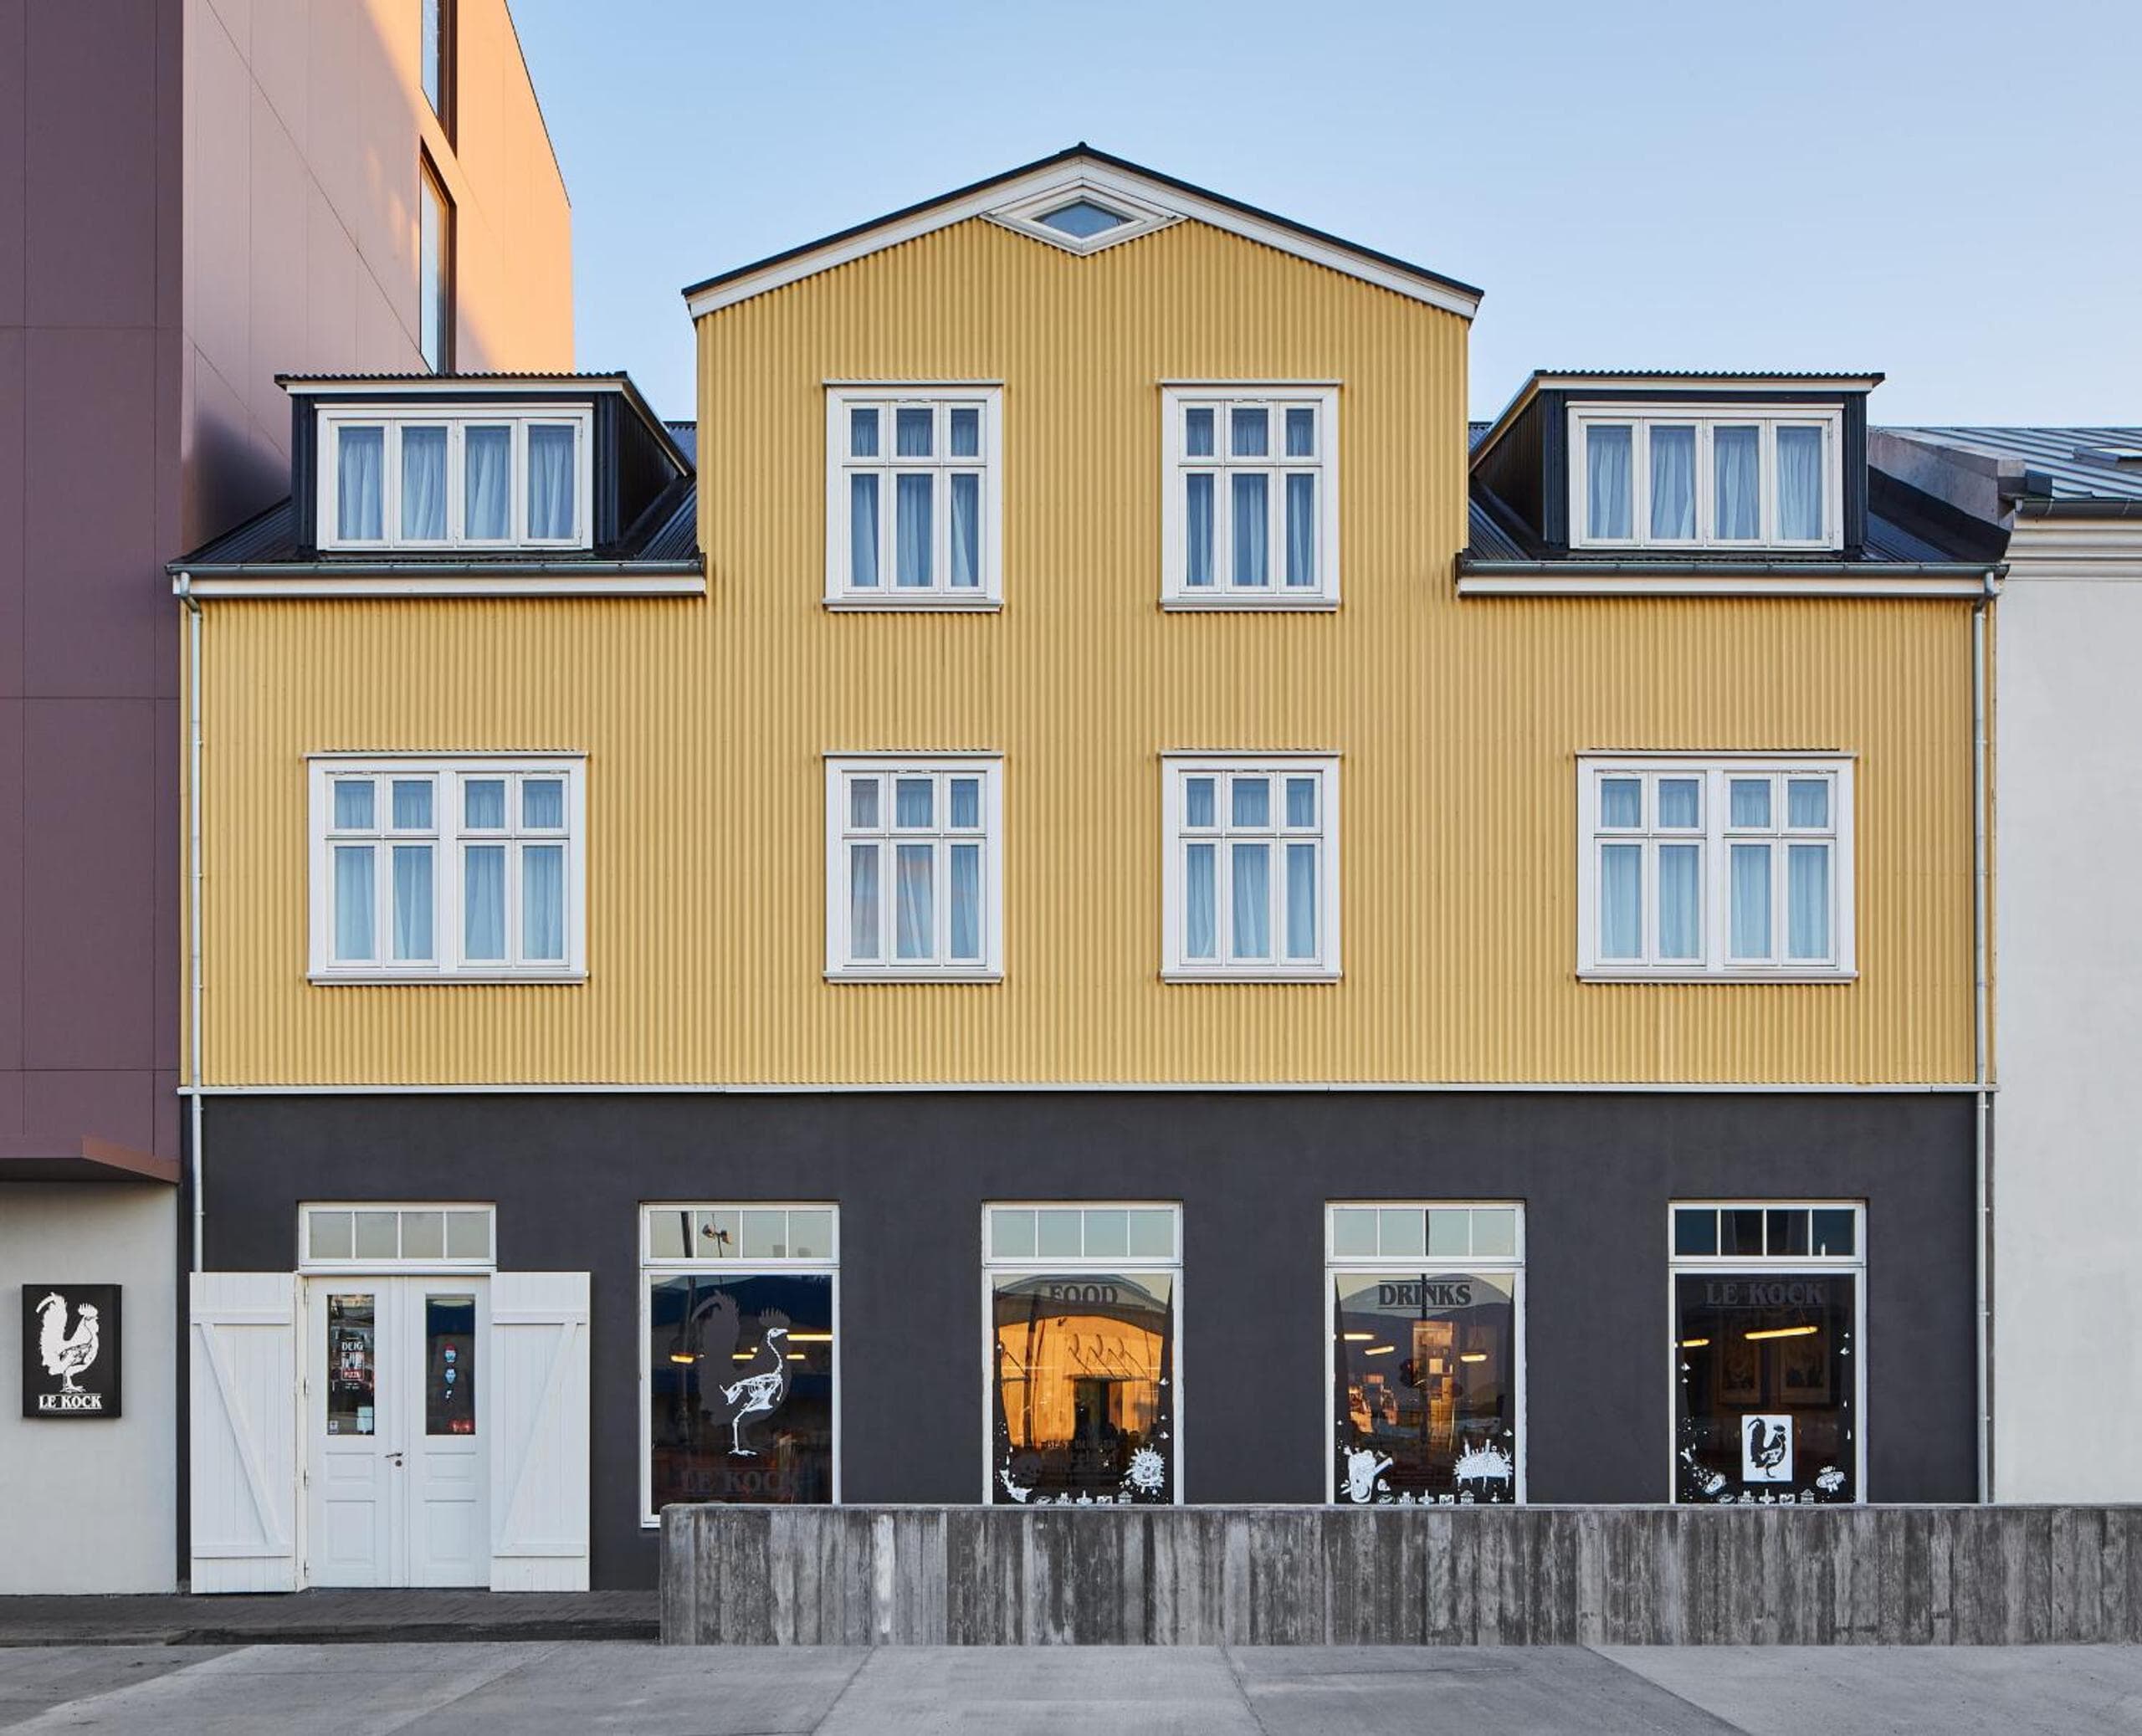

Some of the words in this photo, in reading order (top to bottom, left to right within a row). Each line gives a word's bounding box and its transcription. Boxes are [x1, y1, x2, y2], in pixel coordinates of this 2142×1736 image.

[1049, 1284, 1118, 1303] FOOD
[1378, 1284, 1472, 1306] DRINKS
[1704, 1283, 1739, 1305] LE
[1748, 1283, 1822, 1305] KOCK
[341, 1341, 363, 1351] DEIG
[38, 1395, 56, 1409] LE
[61, 1395, 102, 1409] KOCK
